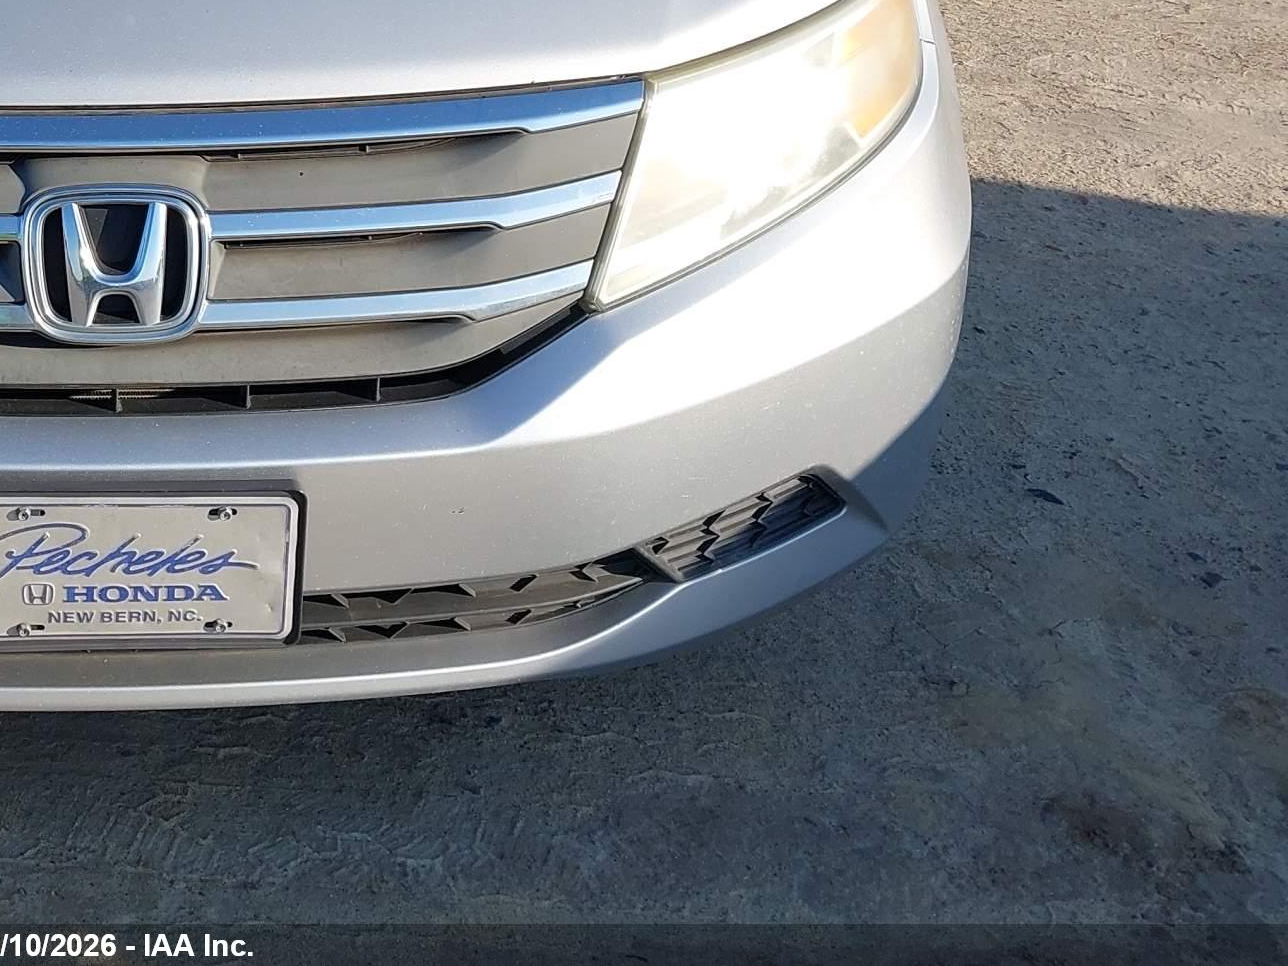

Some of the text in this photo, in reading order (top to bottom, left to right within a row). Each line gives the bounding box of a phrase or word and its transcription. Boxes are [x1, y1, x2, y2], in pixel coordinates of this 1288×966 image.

[63, 585, 228, 604] HONDA
[47, 609, 204, 626] NEW BERN, NC.
